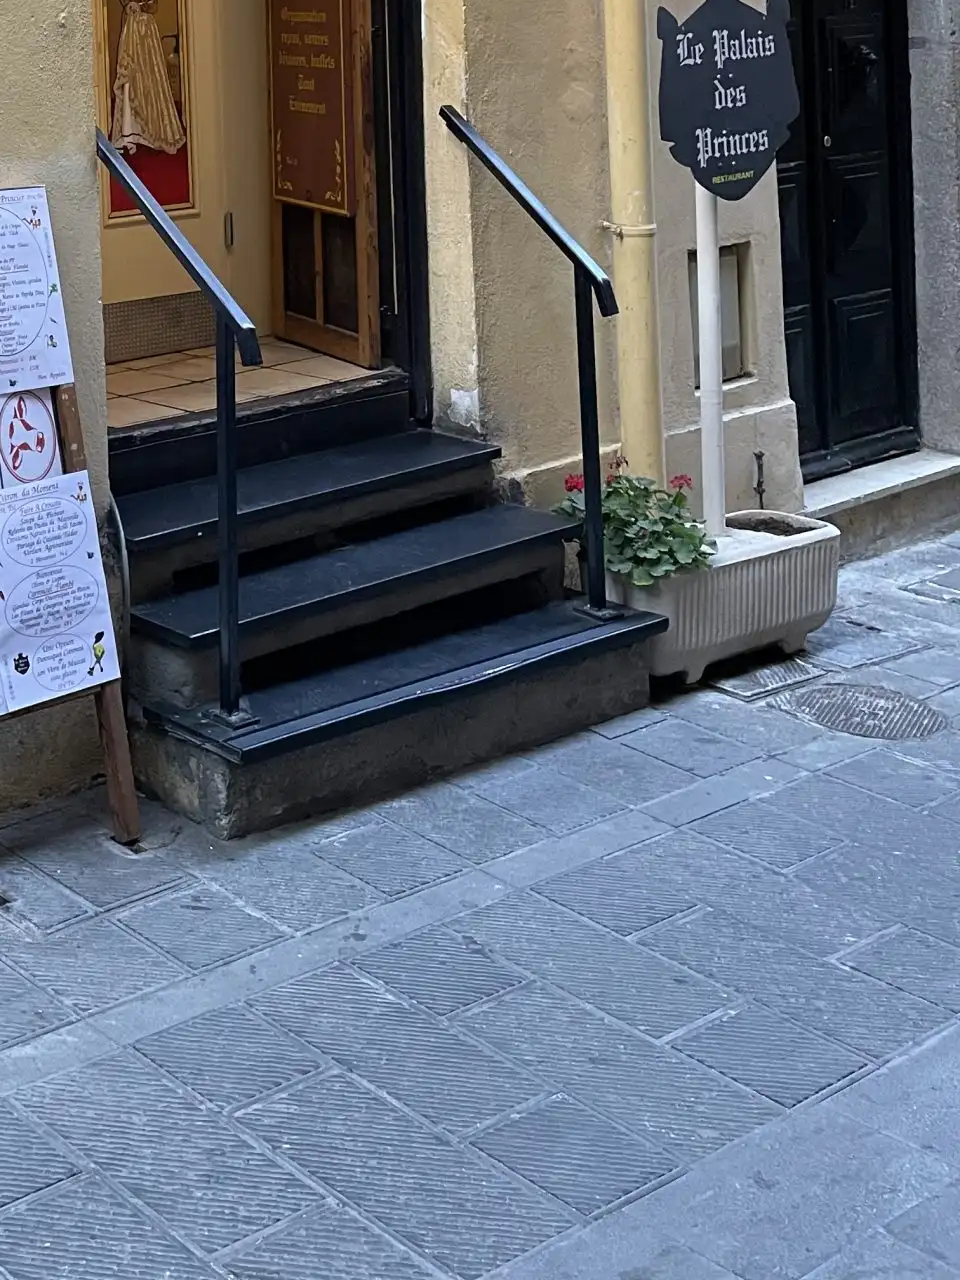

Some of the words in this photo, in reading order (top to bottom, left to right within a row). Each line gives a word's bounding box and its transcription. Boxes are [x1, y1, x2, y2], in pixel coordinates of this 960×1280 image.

[676, 33, 704, 66] Le
[713, 29, 776, 69] Palais
[713, 79, 747, 110] des
[695, 127, 769, 168] Princes
[712, 170, 755, 185] RESTAURANT
[31, 480, 58, 494] Moment
